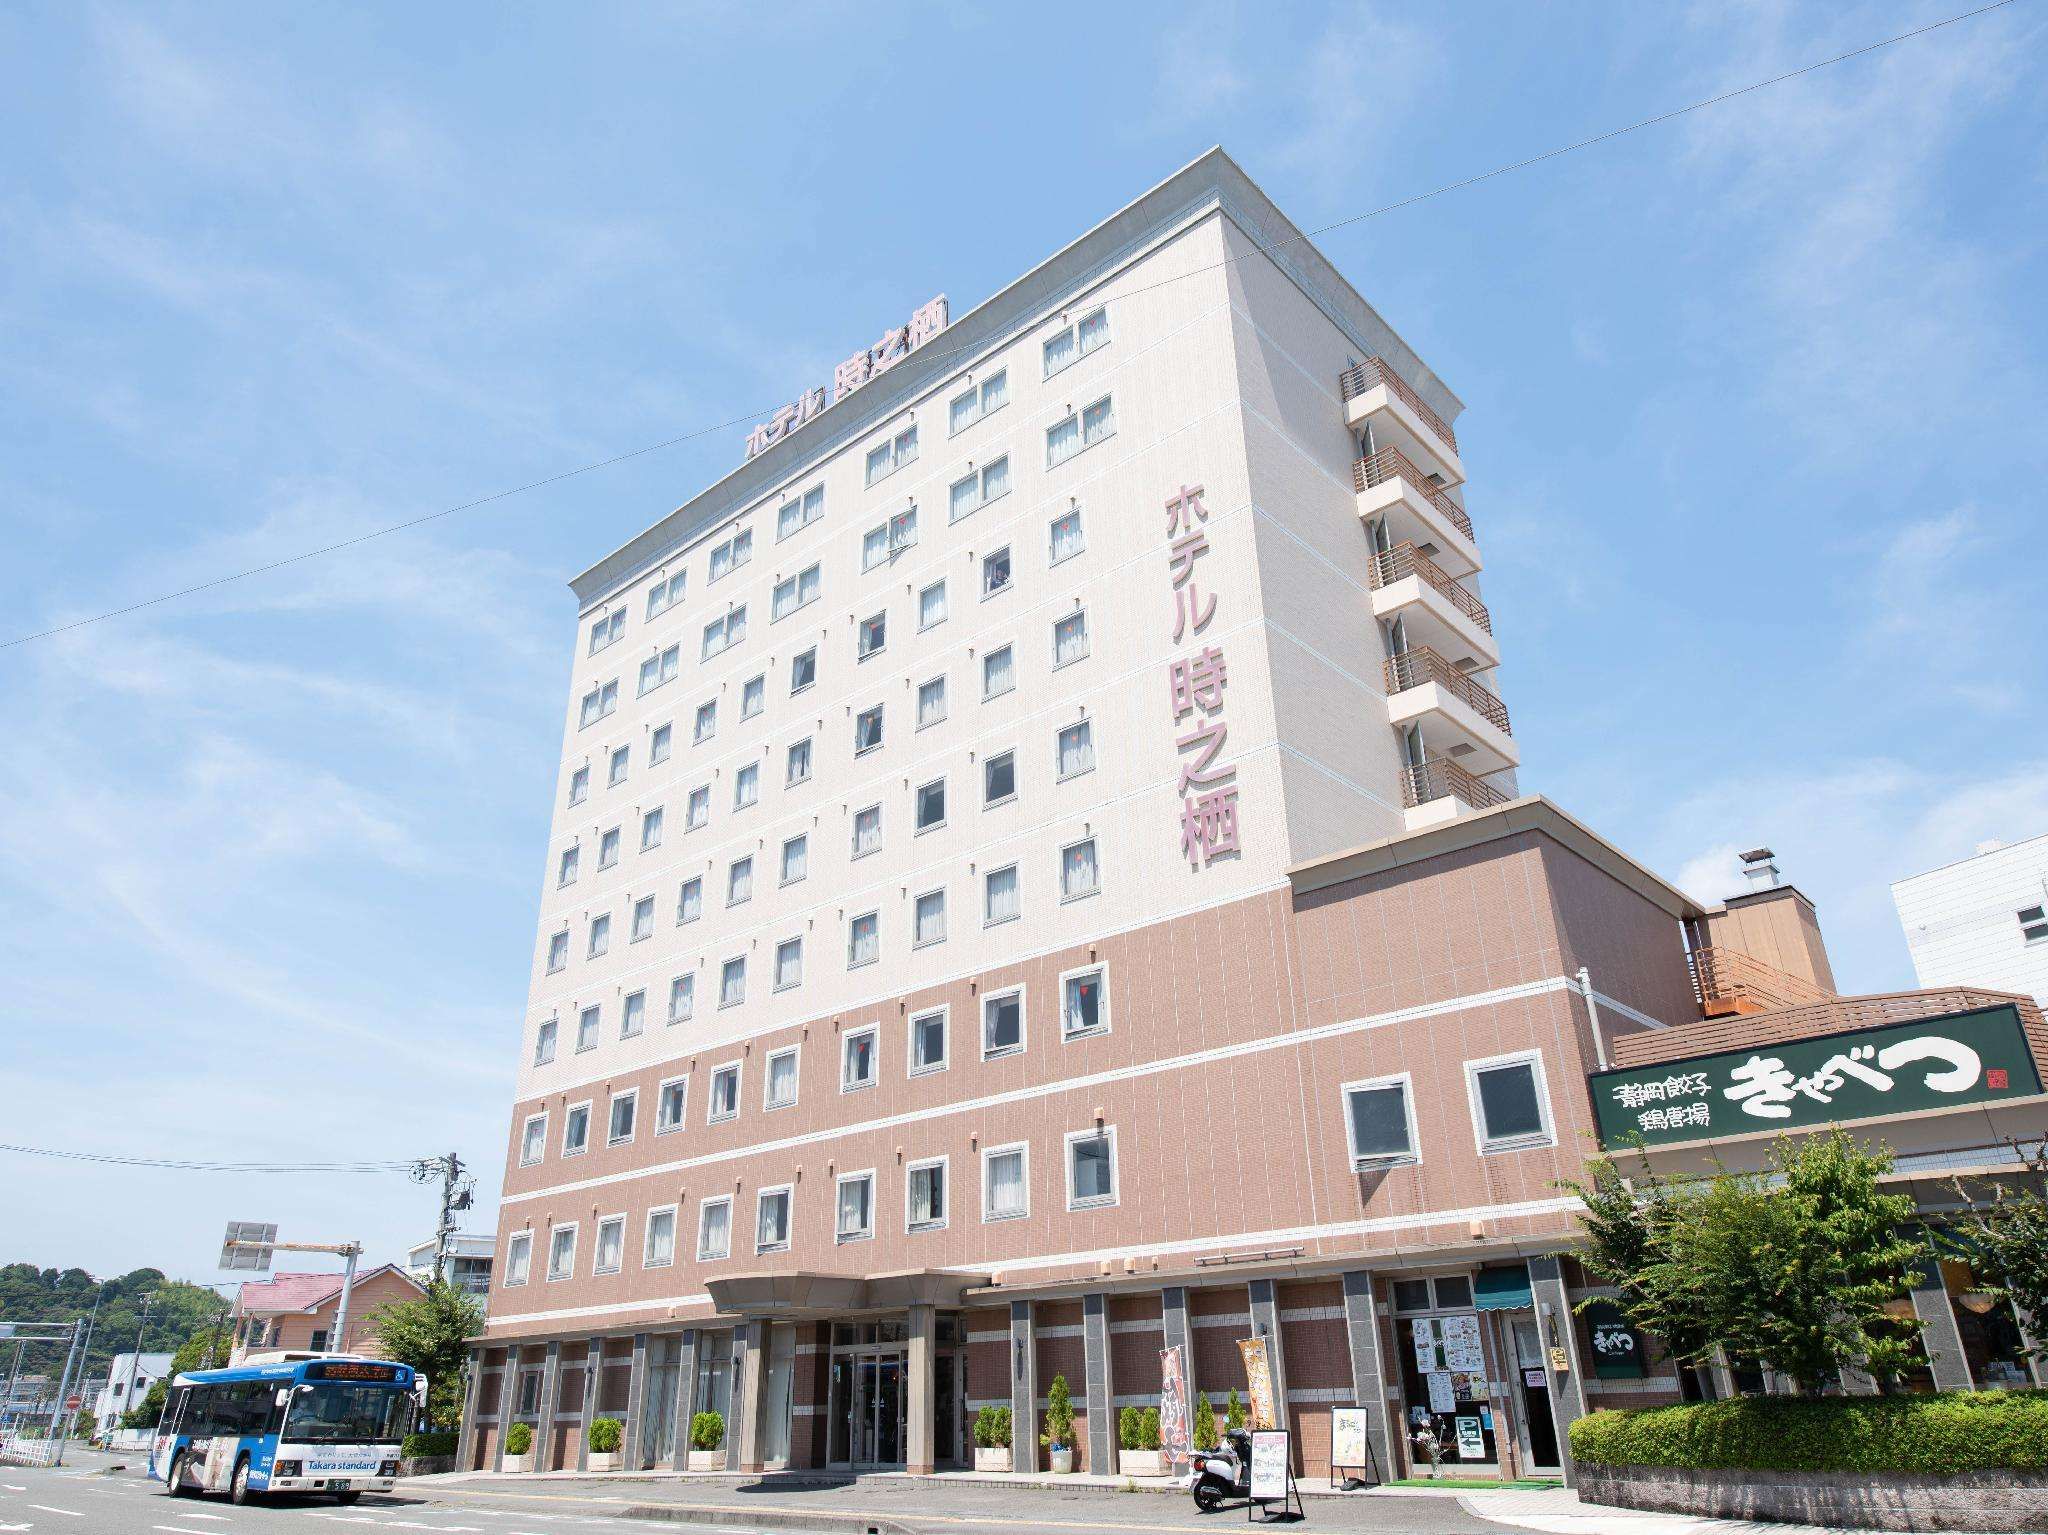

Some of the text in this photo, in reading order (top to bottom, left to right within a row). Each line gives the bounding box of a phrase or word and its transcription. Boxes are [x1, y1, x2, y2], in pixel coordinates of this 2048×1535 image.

[745, 386, 825, 460] ホテル
[1612, 1072, 1712, 1108] 静岡餃子
[1723, 1036, 1981, 1118] きゃべつ
[1594, 1330, 1633, 1353] きゃべつ
[1459, 1420, 1477, 1430] P
[308, 1460, 377, 1470] Takara standard
